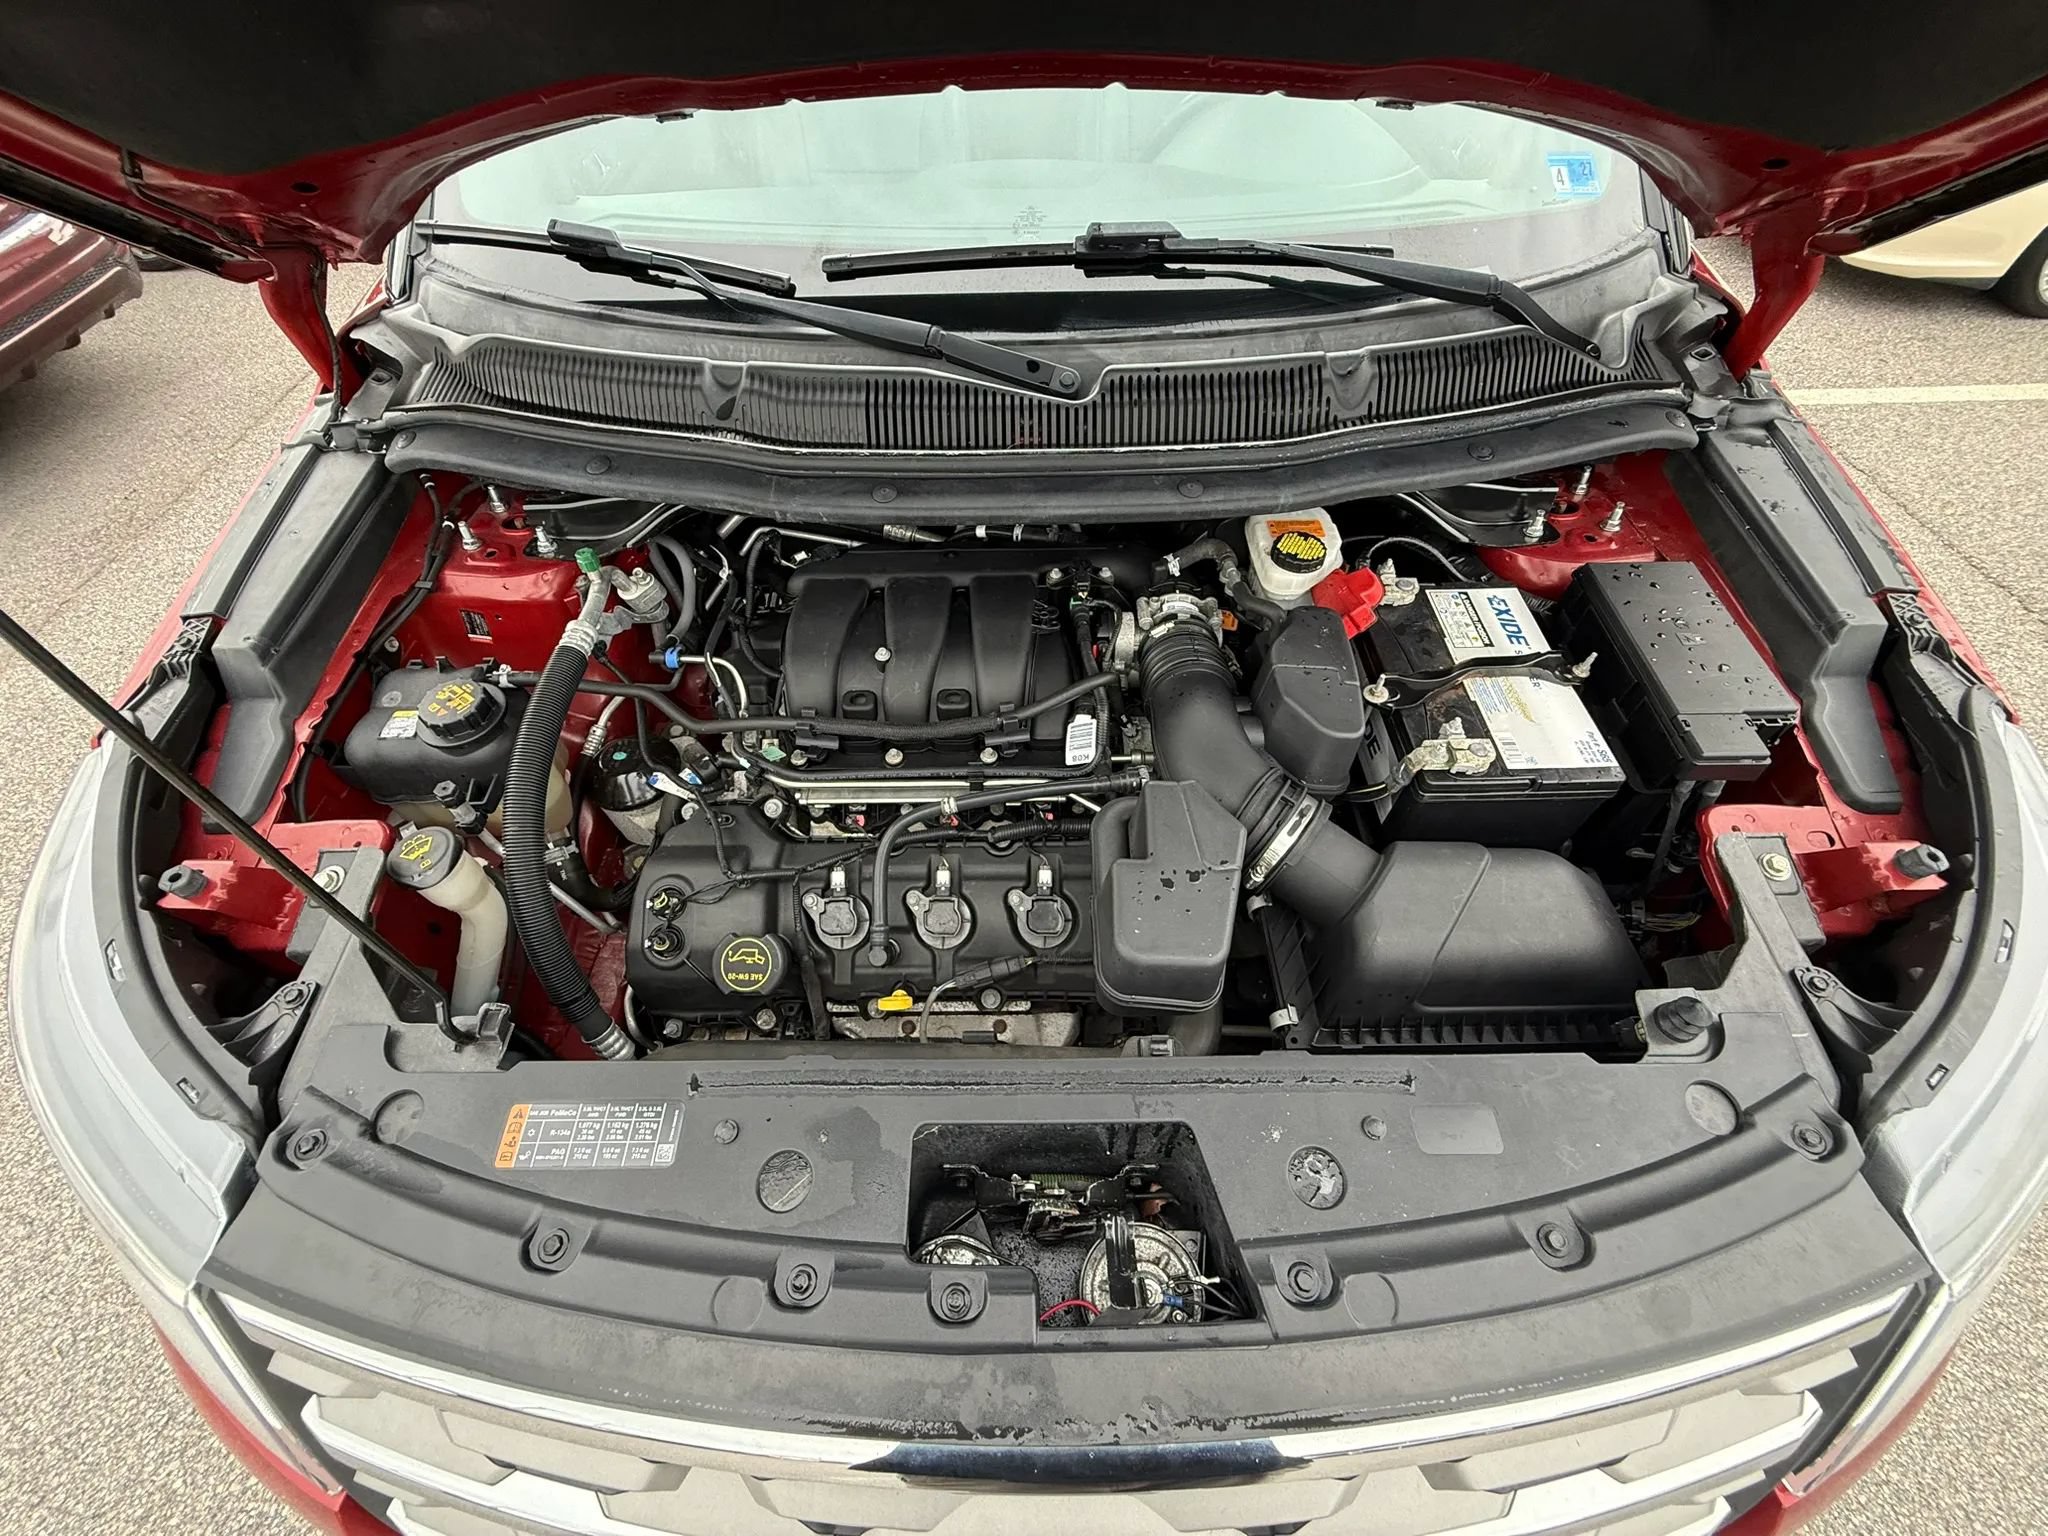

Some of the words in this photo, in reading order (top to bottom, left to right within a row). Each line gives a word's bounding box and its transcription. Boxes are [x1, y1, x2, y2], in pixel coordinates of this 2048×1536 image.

[1557, 168, 1564, 185] 4
[1580, 162, 1592, 176] 27
[1463, 600, 1478, 621] DANGER
[1487, 594, 1530, 646] EXIDE
[1072, 754, 1089, 762] K08
